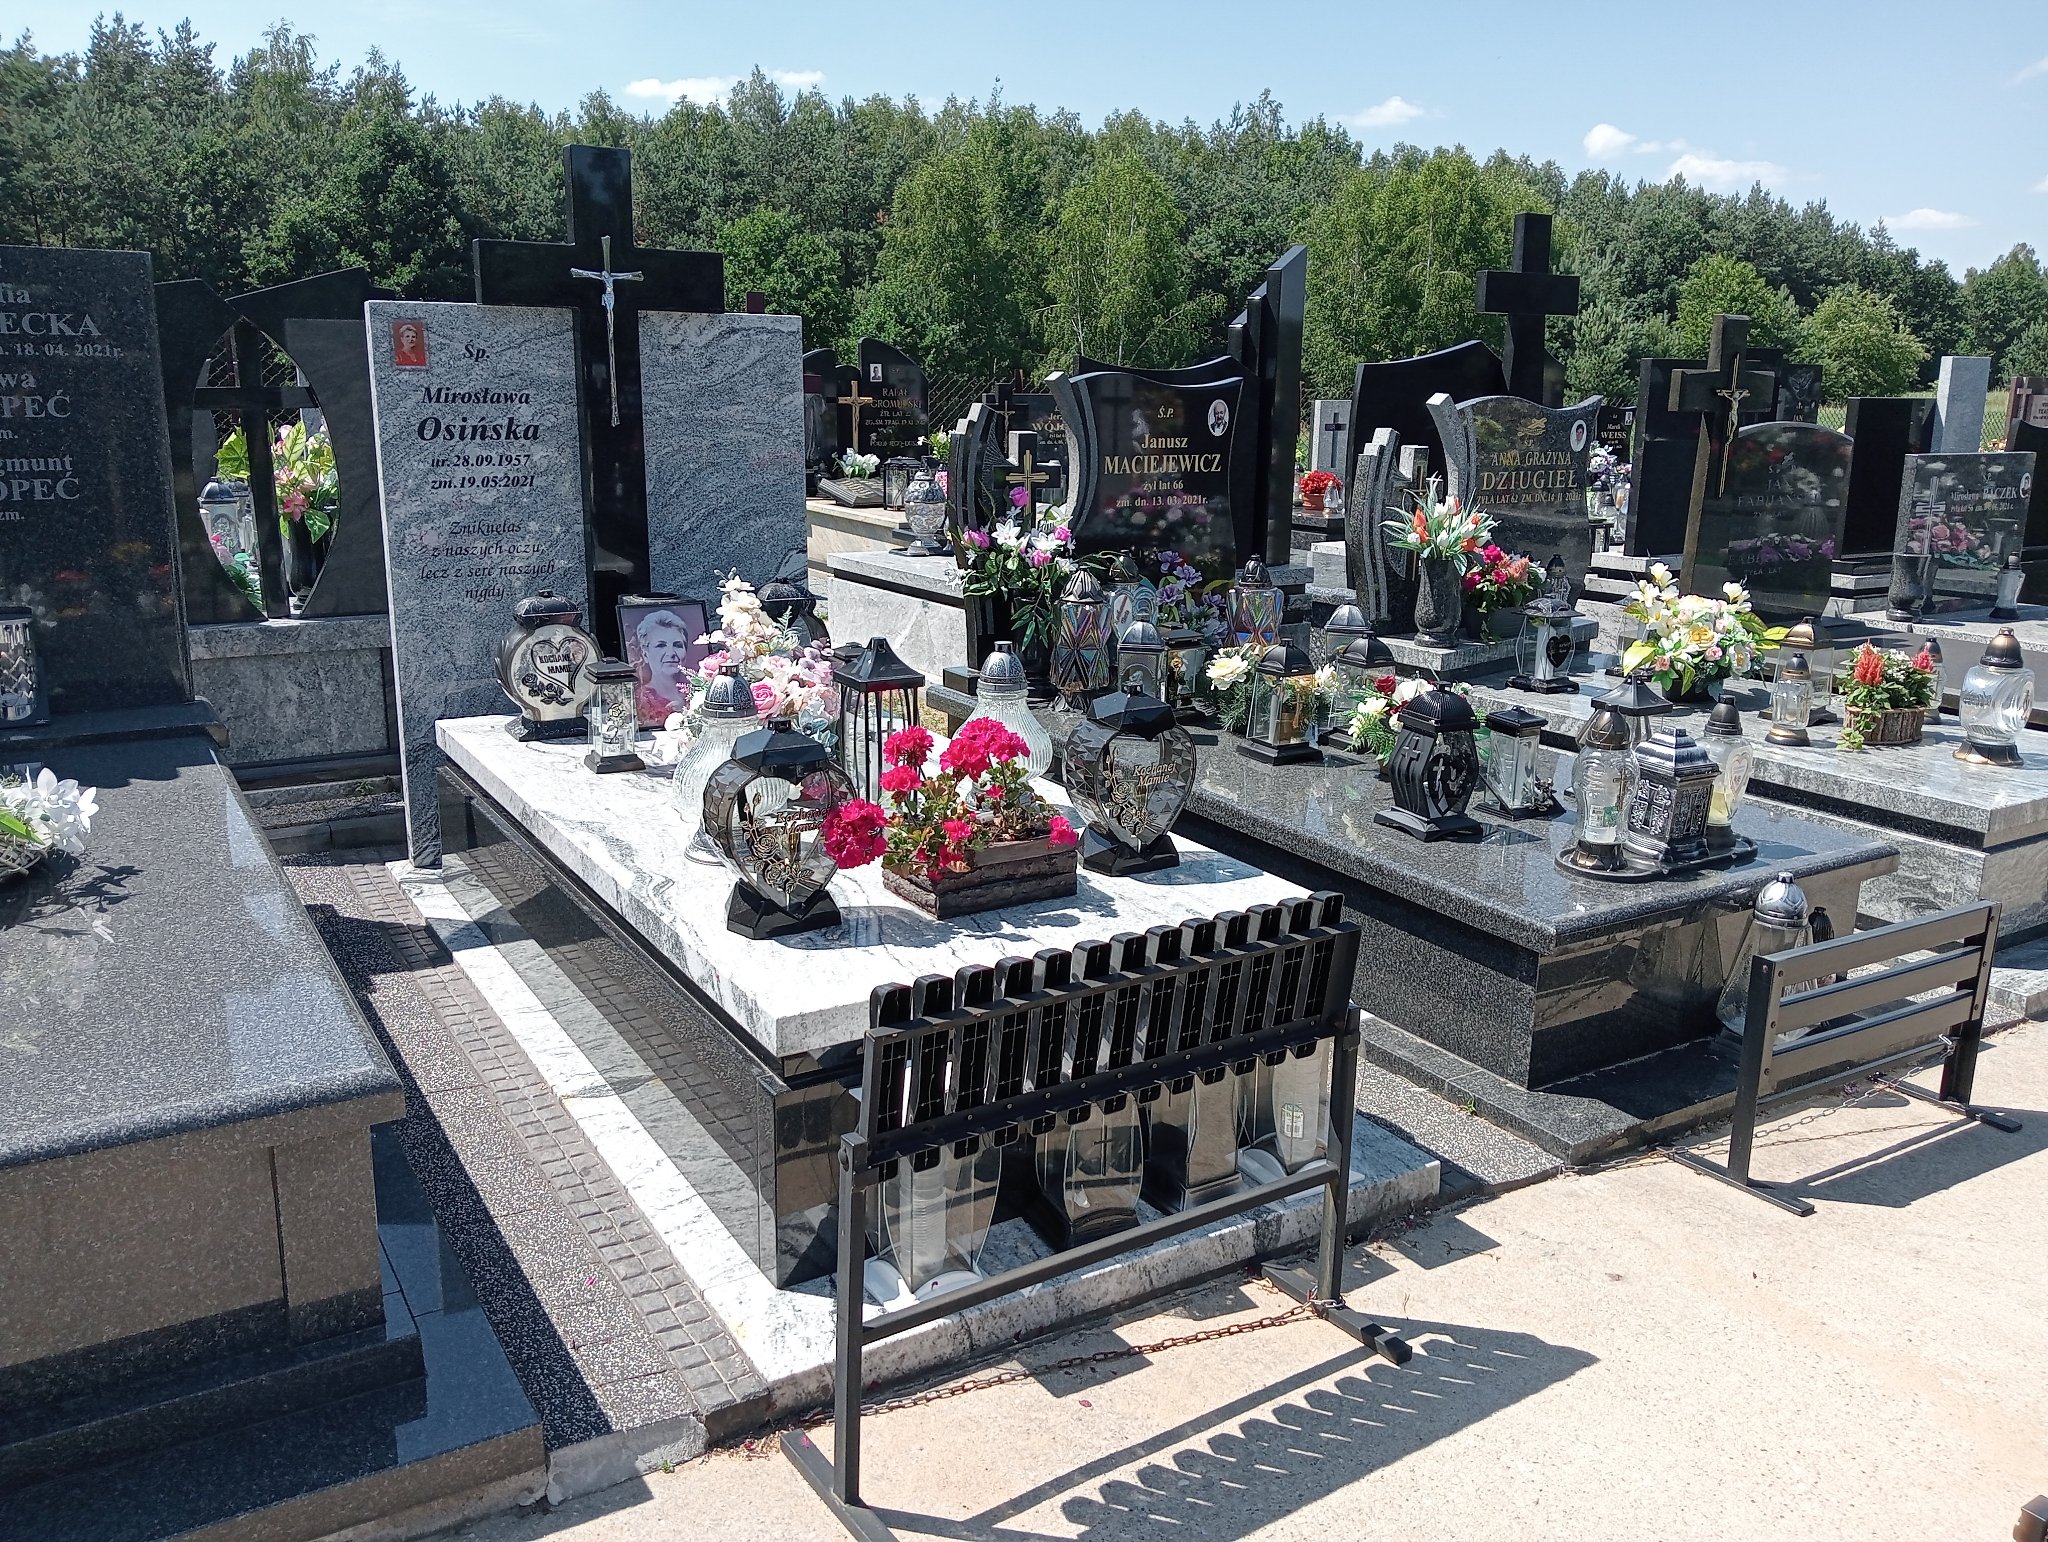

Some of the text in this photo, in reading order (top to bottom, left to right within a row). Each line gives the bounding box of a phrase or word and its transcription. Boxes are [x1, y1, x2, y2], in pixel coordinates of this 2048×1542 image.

[0, 311, 102, 336] ECKA
[463, 340, 490, 362] Śp.
[421, 386, 531, 404] Mirosława
[417, 416, 541, 441] Osińska
[1600, 431, 1627, 439] WEISS
[1141, 433, 1188, 449] Janusz
[1104, 454, 1221, 475] MACIEJEWICZ
[1491, 448, 1572, 466] ANNA GRAŻYNA
[1159, 481, 1171, 490] lat
[1172, 480, 1184, 490] 66
[1480, 469, 1578, 491] DZIUGIEŁ
[1116, 499, 1132, 508] zm.
[1135, 497, 1149, 506] dn.
[445, 540, 504, 560] naszych
[420, 564, 450, 580] lecz
[454, 568, 463, 578] z
[500, 559, 556, 579] naszych
[1133, 760, 1177, 777] Kochanej
[1138, 773, 1170, 787] Mamie
[775, 807, 830, 824] Kochane
